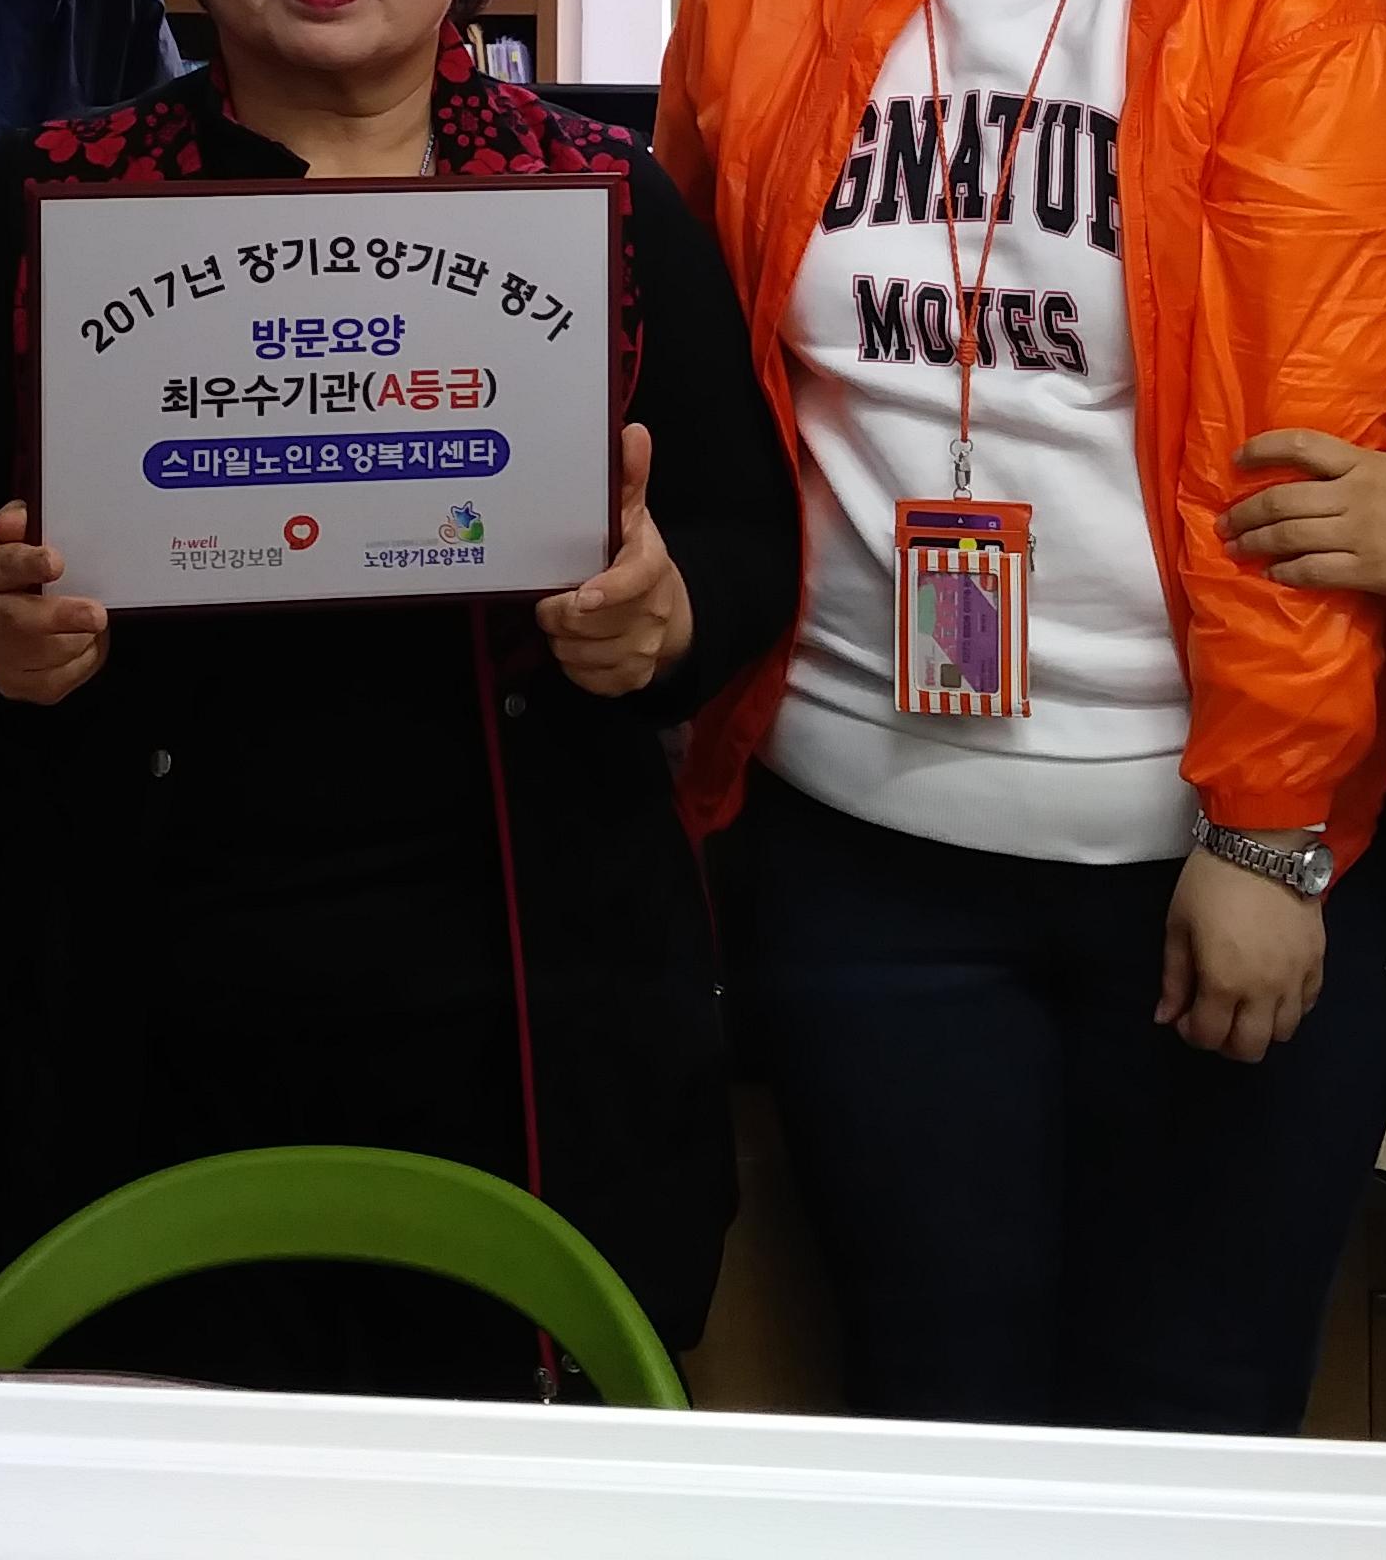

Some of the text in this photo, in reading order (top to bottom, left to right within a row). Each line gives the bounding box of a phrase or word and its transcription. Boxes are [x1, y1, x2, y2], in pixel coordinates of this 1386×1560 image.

[80, 236, 576, 354] 2017년 장기요양기관 평가
[251, 314, 406, 360] 방문요양
[161, 368, 498, 419] 최우수기관(A등급)
[161, 440, 498, 479] 스마일노인요양복지센타
[169, 547, 284, 571] 국민건강보험
[364, 546, 485, 569] 노인장기요양보험
